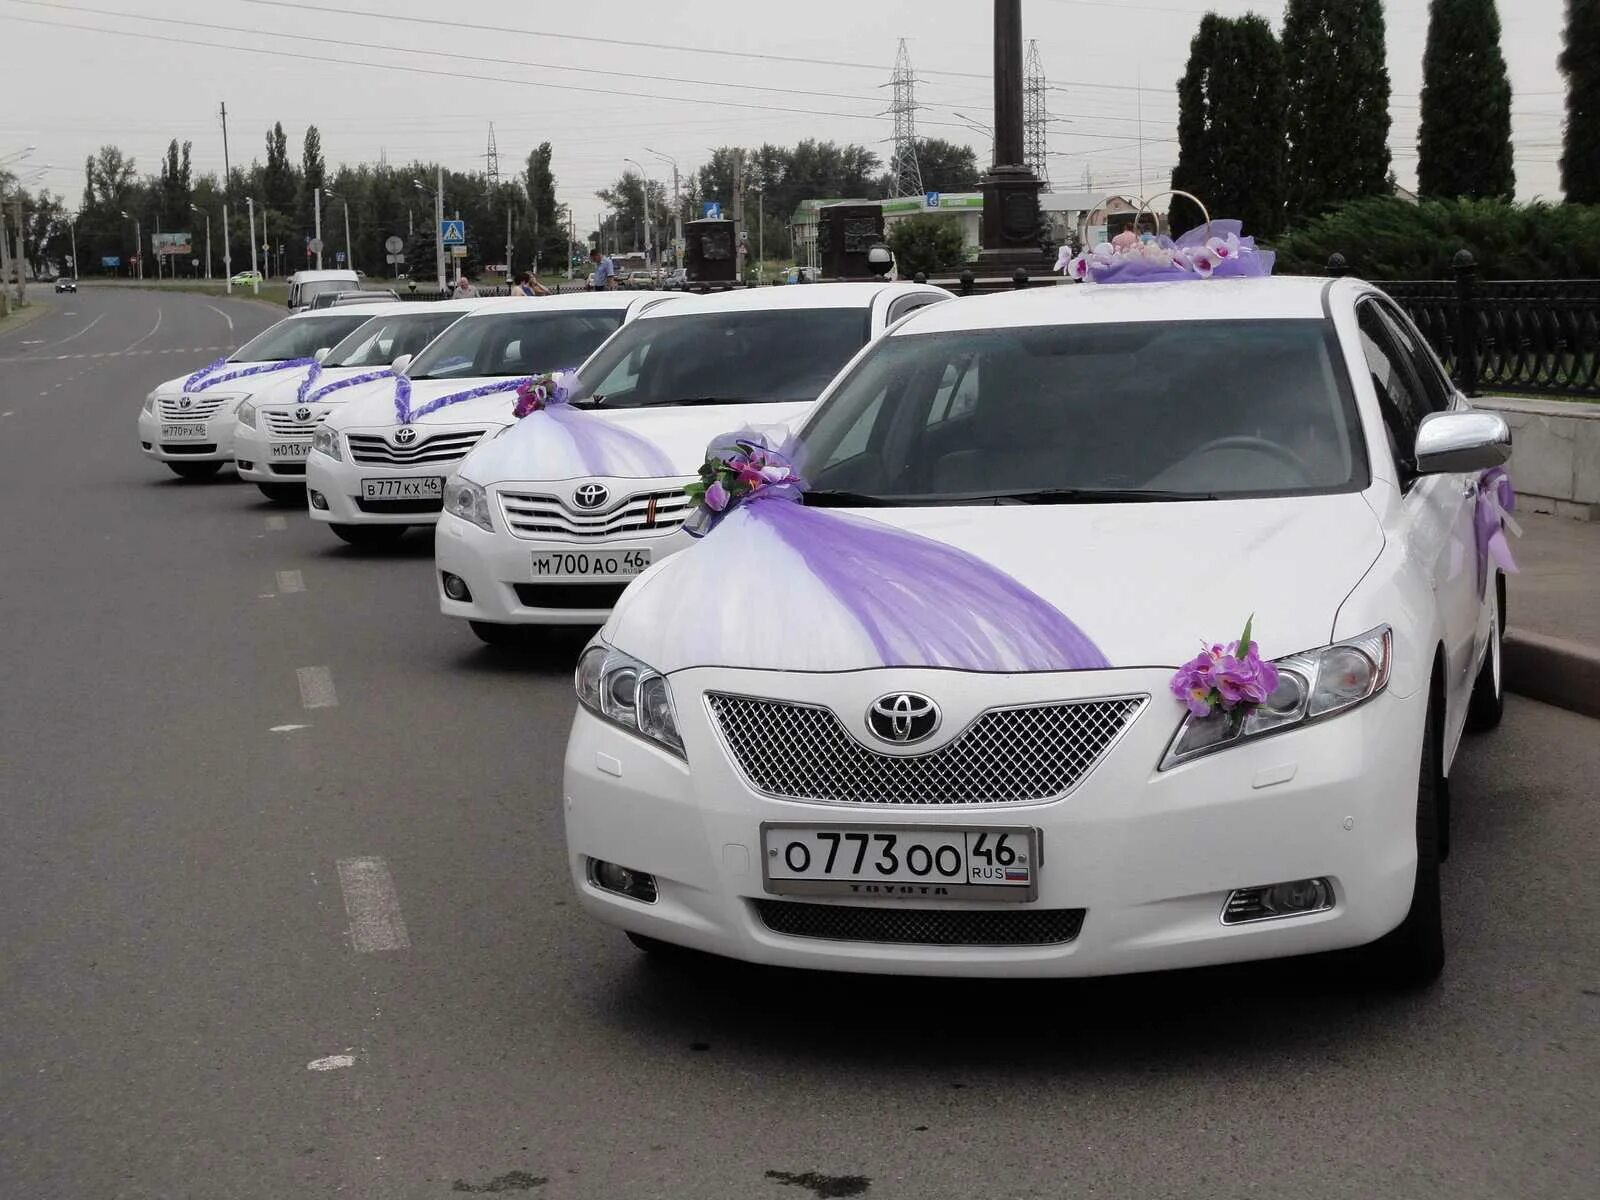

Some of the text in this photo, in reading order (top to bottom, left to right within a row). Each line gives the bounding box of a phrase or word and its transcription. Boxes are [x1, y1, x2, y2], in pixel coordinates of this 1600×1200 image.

[424, 479, 437, 490] 46
[623, 551, 644, 567] 46
[972, 832, 1016, 866] 46
[972, 868, 1003, 879] RUS
